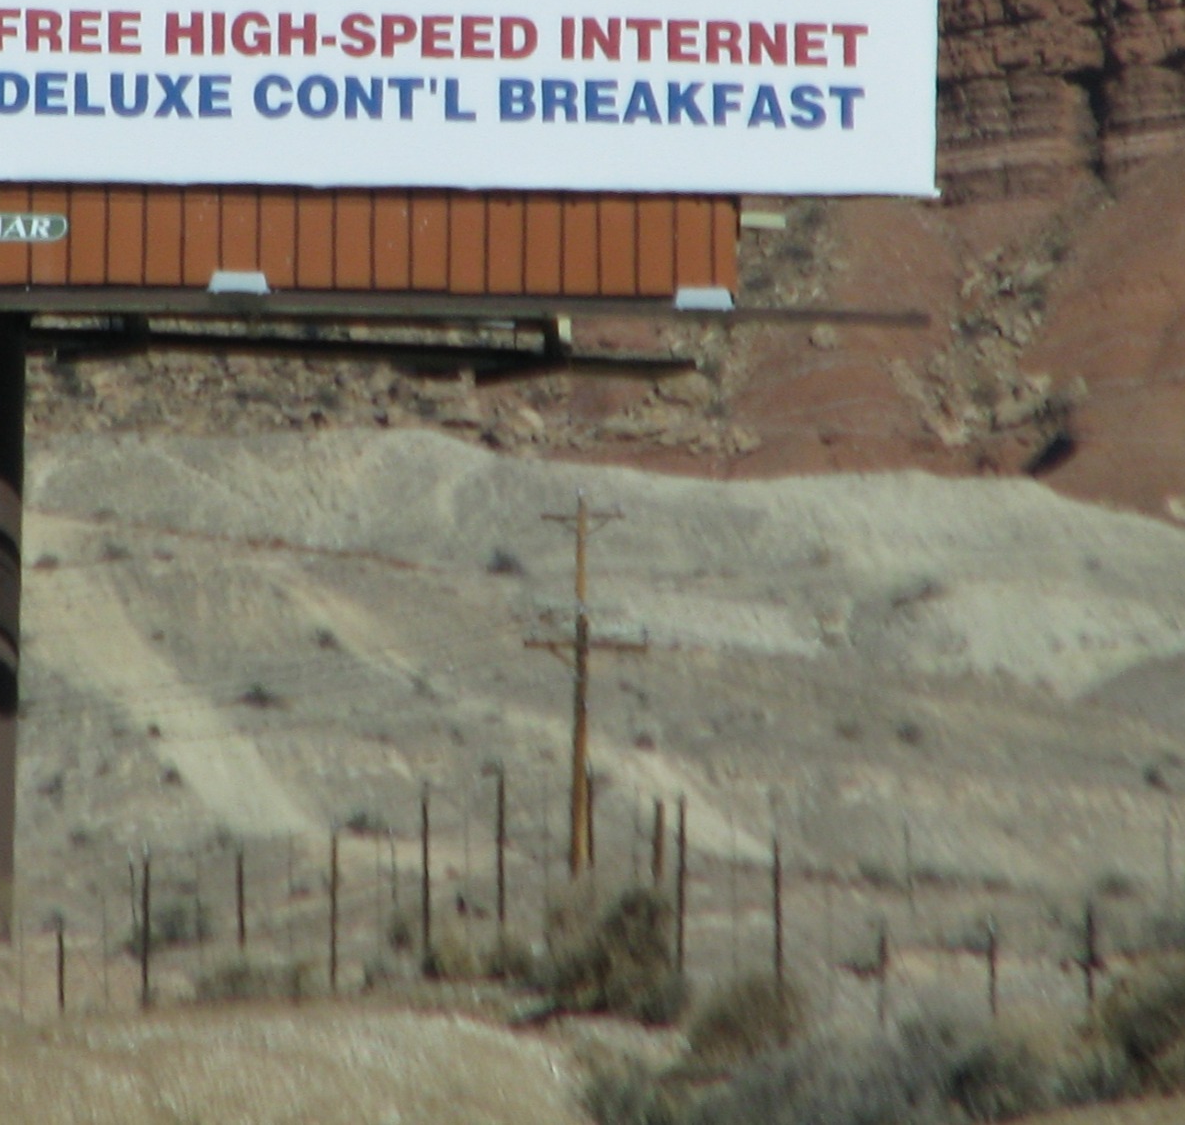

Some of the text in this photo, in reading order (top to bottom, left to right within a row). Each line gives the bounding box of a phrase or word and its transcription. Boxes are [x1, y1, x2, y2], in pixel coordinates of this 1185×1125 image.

[163, 12, 538, 59] HIGH-SPEED
[560, 16, 869, 67] INTERNET
[253, 76, 477, 122] CONT'L
[497, 78, 866, 129] BREAKFAST
